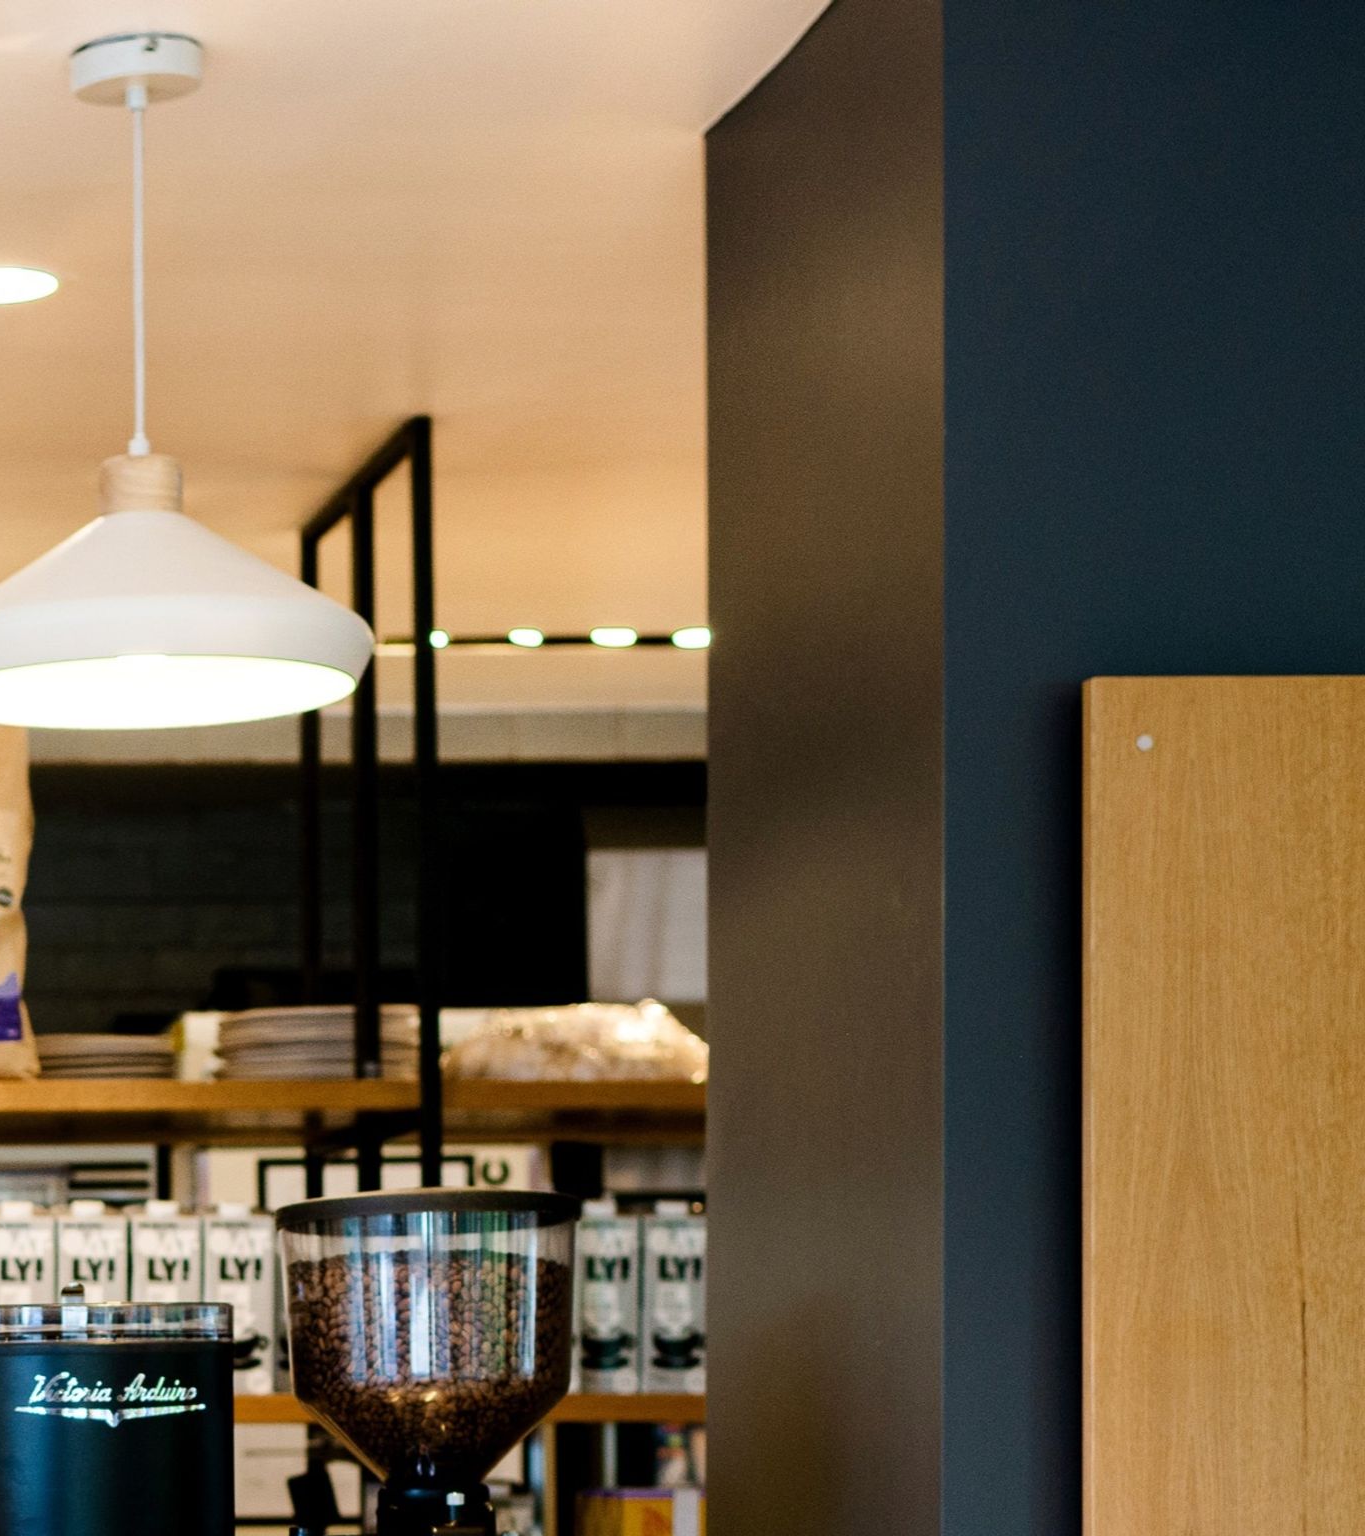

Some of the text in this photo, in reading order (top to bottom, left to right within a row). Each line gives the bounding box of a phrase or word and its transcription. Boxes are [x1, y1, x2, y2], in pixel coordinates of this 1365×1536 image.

[1, 1258, 43, 1281] LY!
[73, 1258, 115, 1281] LY!
[148, 1258, 190, 1281] LY!
[220, 1258, 262, 1281] LY!
[29, 1371, 197, 1404] Victoria Arduino
